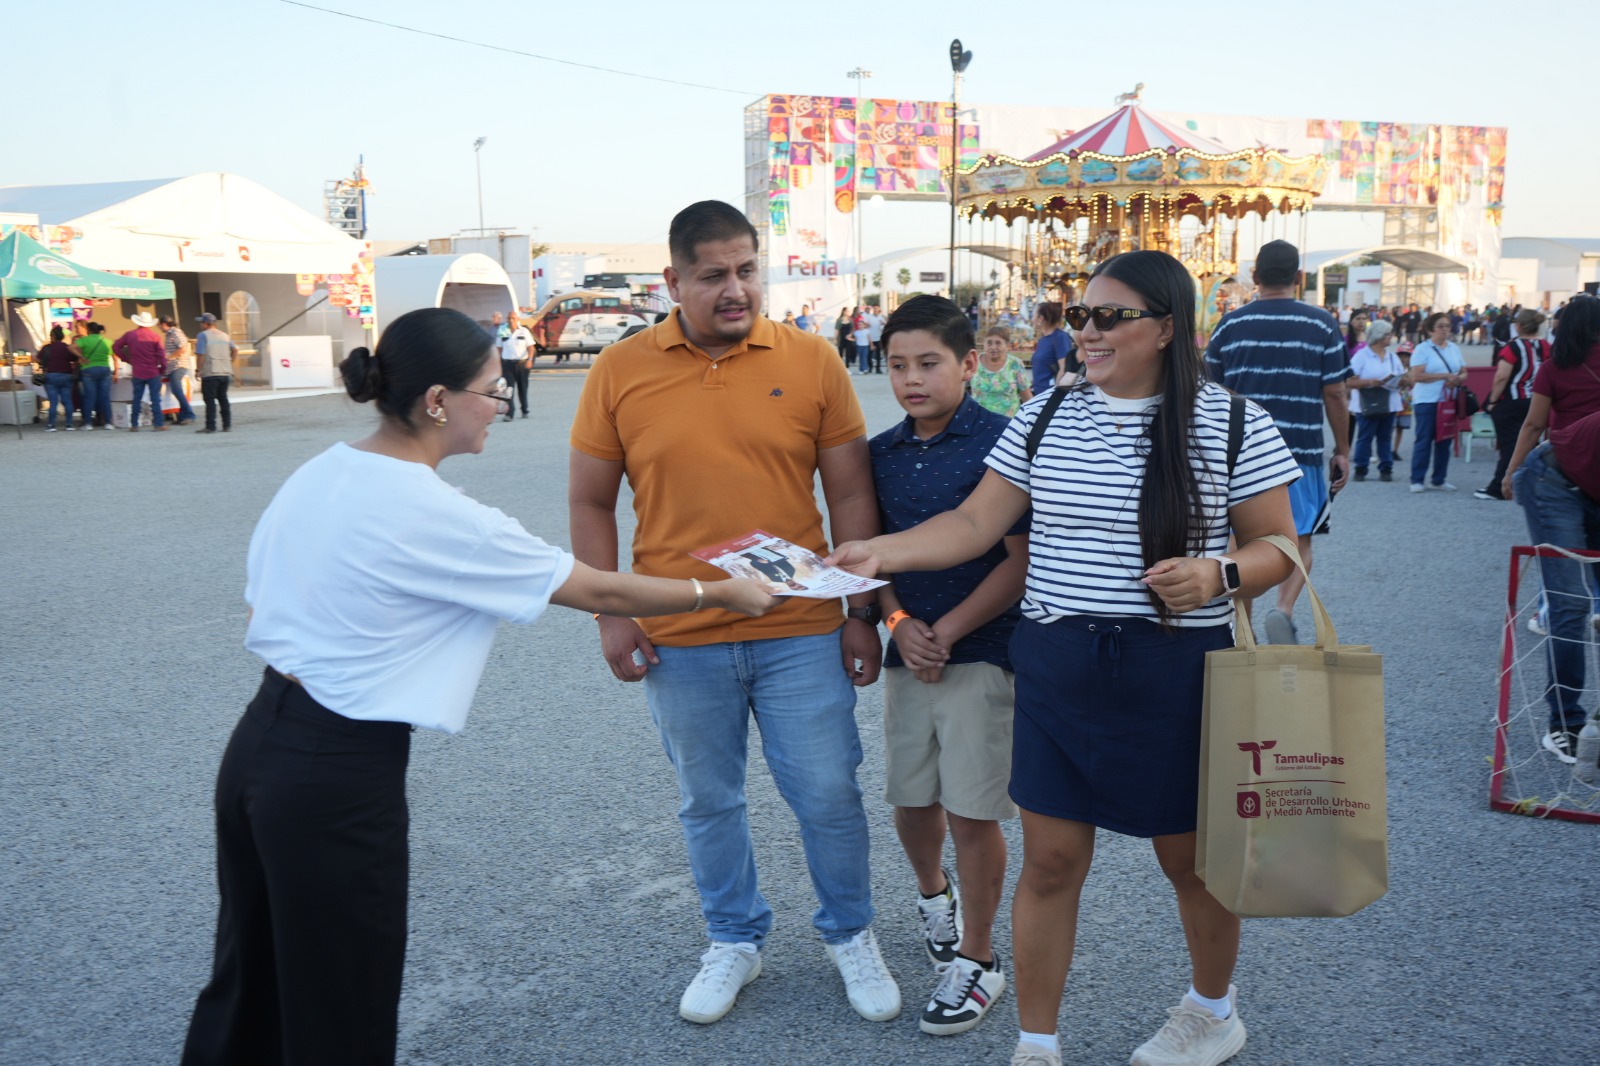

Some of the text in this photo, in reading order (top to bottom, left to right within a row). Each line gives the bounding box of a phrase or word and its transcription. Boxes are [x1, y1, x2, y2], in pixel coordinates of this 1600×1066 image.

[788, 254, 838, 276] Feria
[36, 282, 150, 298] Jaumave, Tamaulipas
[1273, 752, 1345, 766] Tamaulipas
[1265, 786, 1312, 798] Secretaría
[1265, 797, 1371, 810] de Desarrollo Urbano
[1265, 806, 1356, 820] y Medio Ambiente
